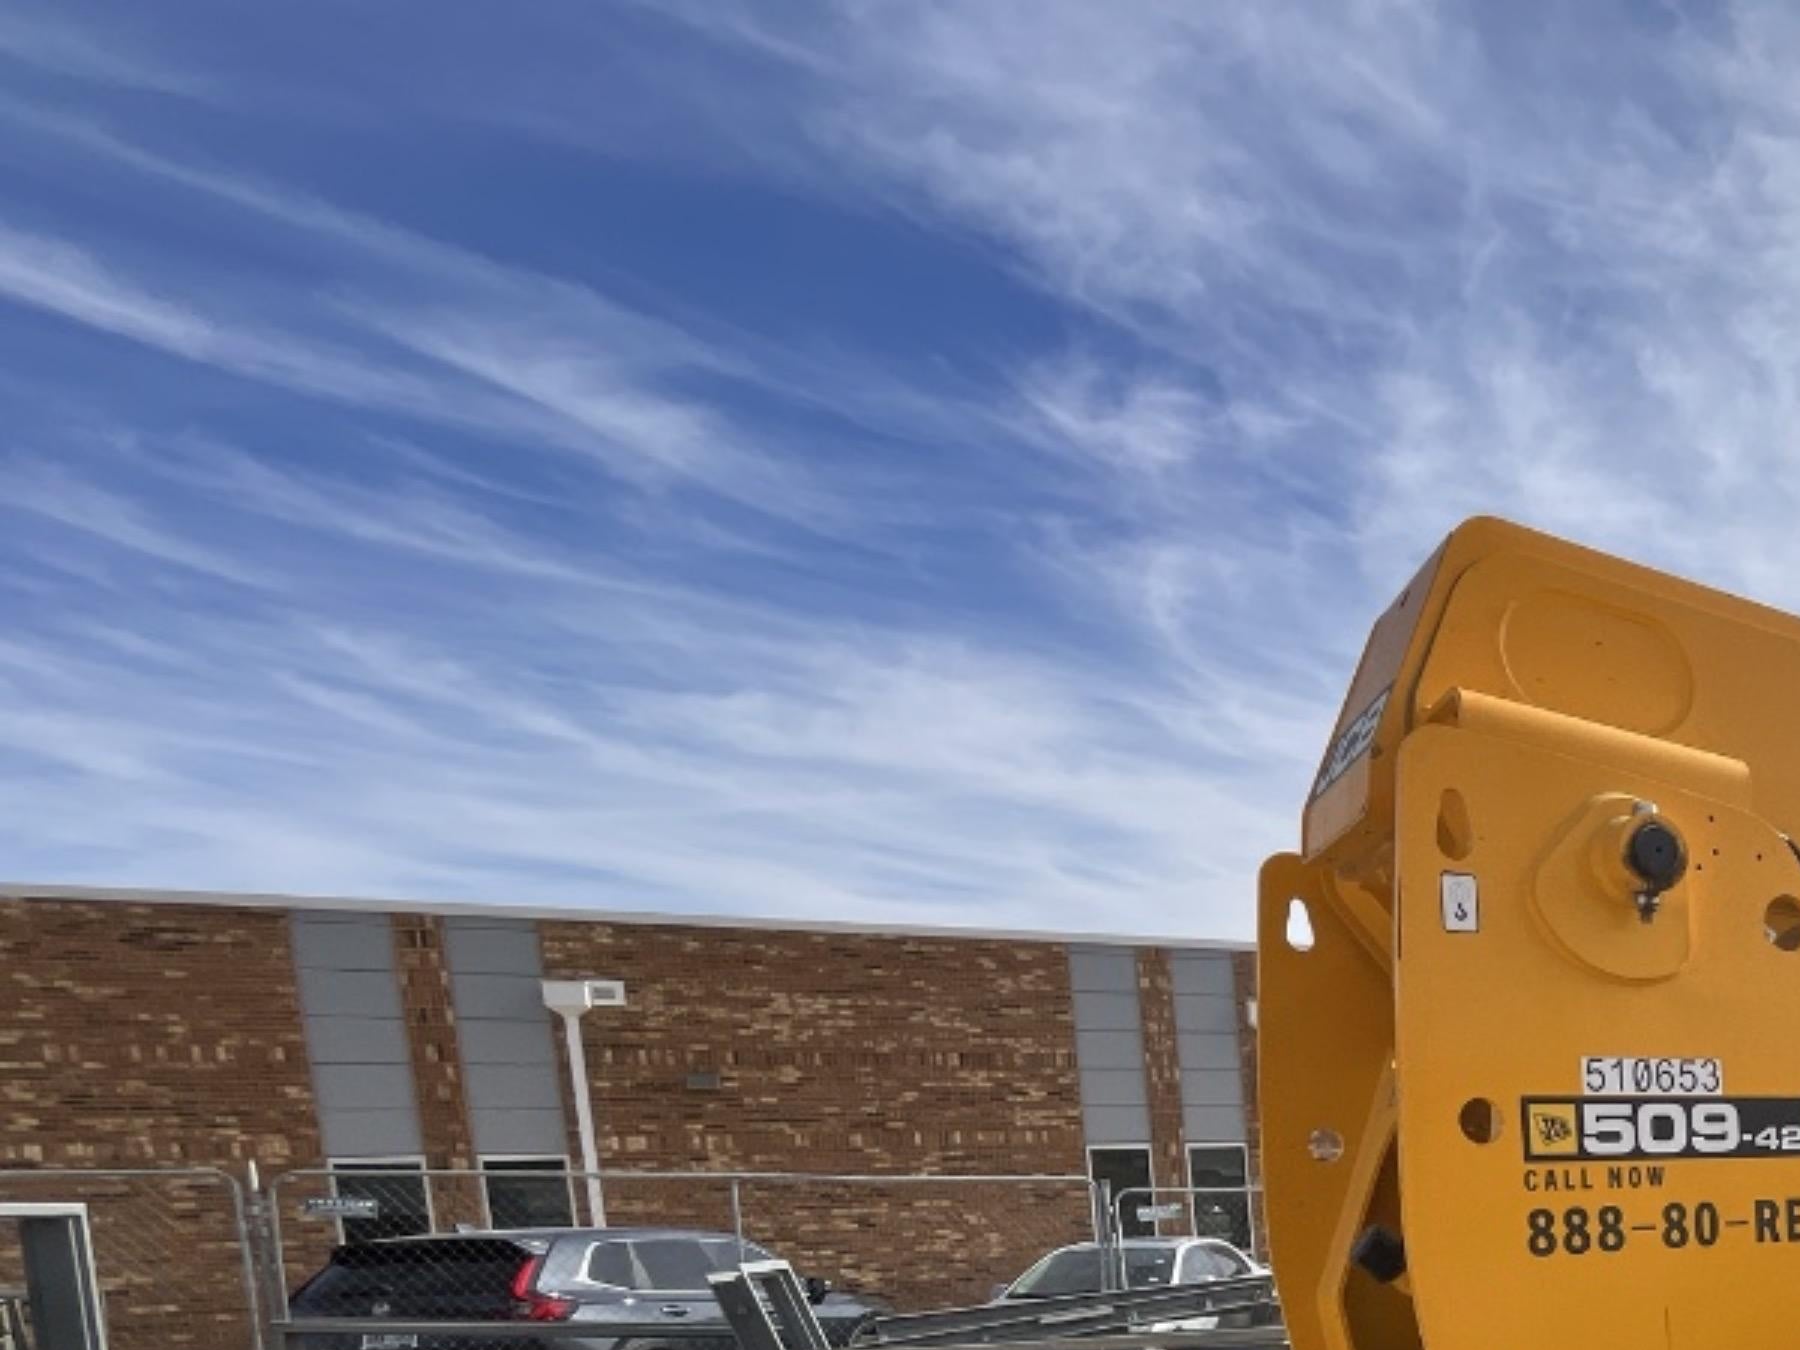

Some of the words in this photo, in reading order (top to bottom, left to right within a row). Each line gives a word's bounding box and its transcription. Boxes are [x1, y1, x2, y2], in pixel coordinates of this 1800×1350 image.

[1586, 1058, 1719, 1093] 510653
[1524, 1168, 1593, 1191] CALL
[1607, 1166, 1664, 1189] NOW
